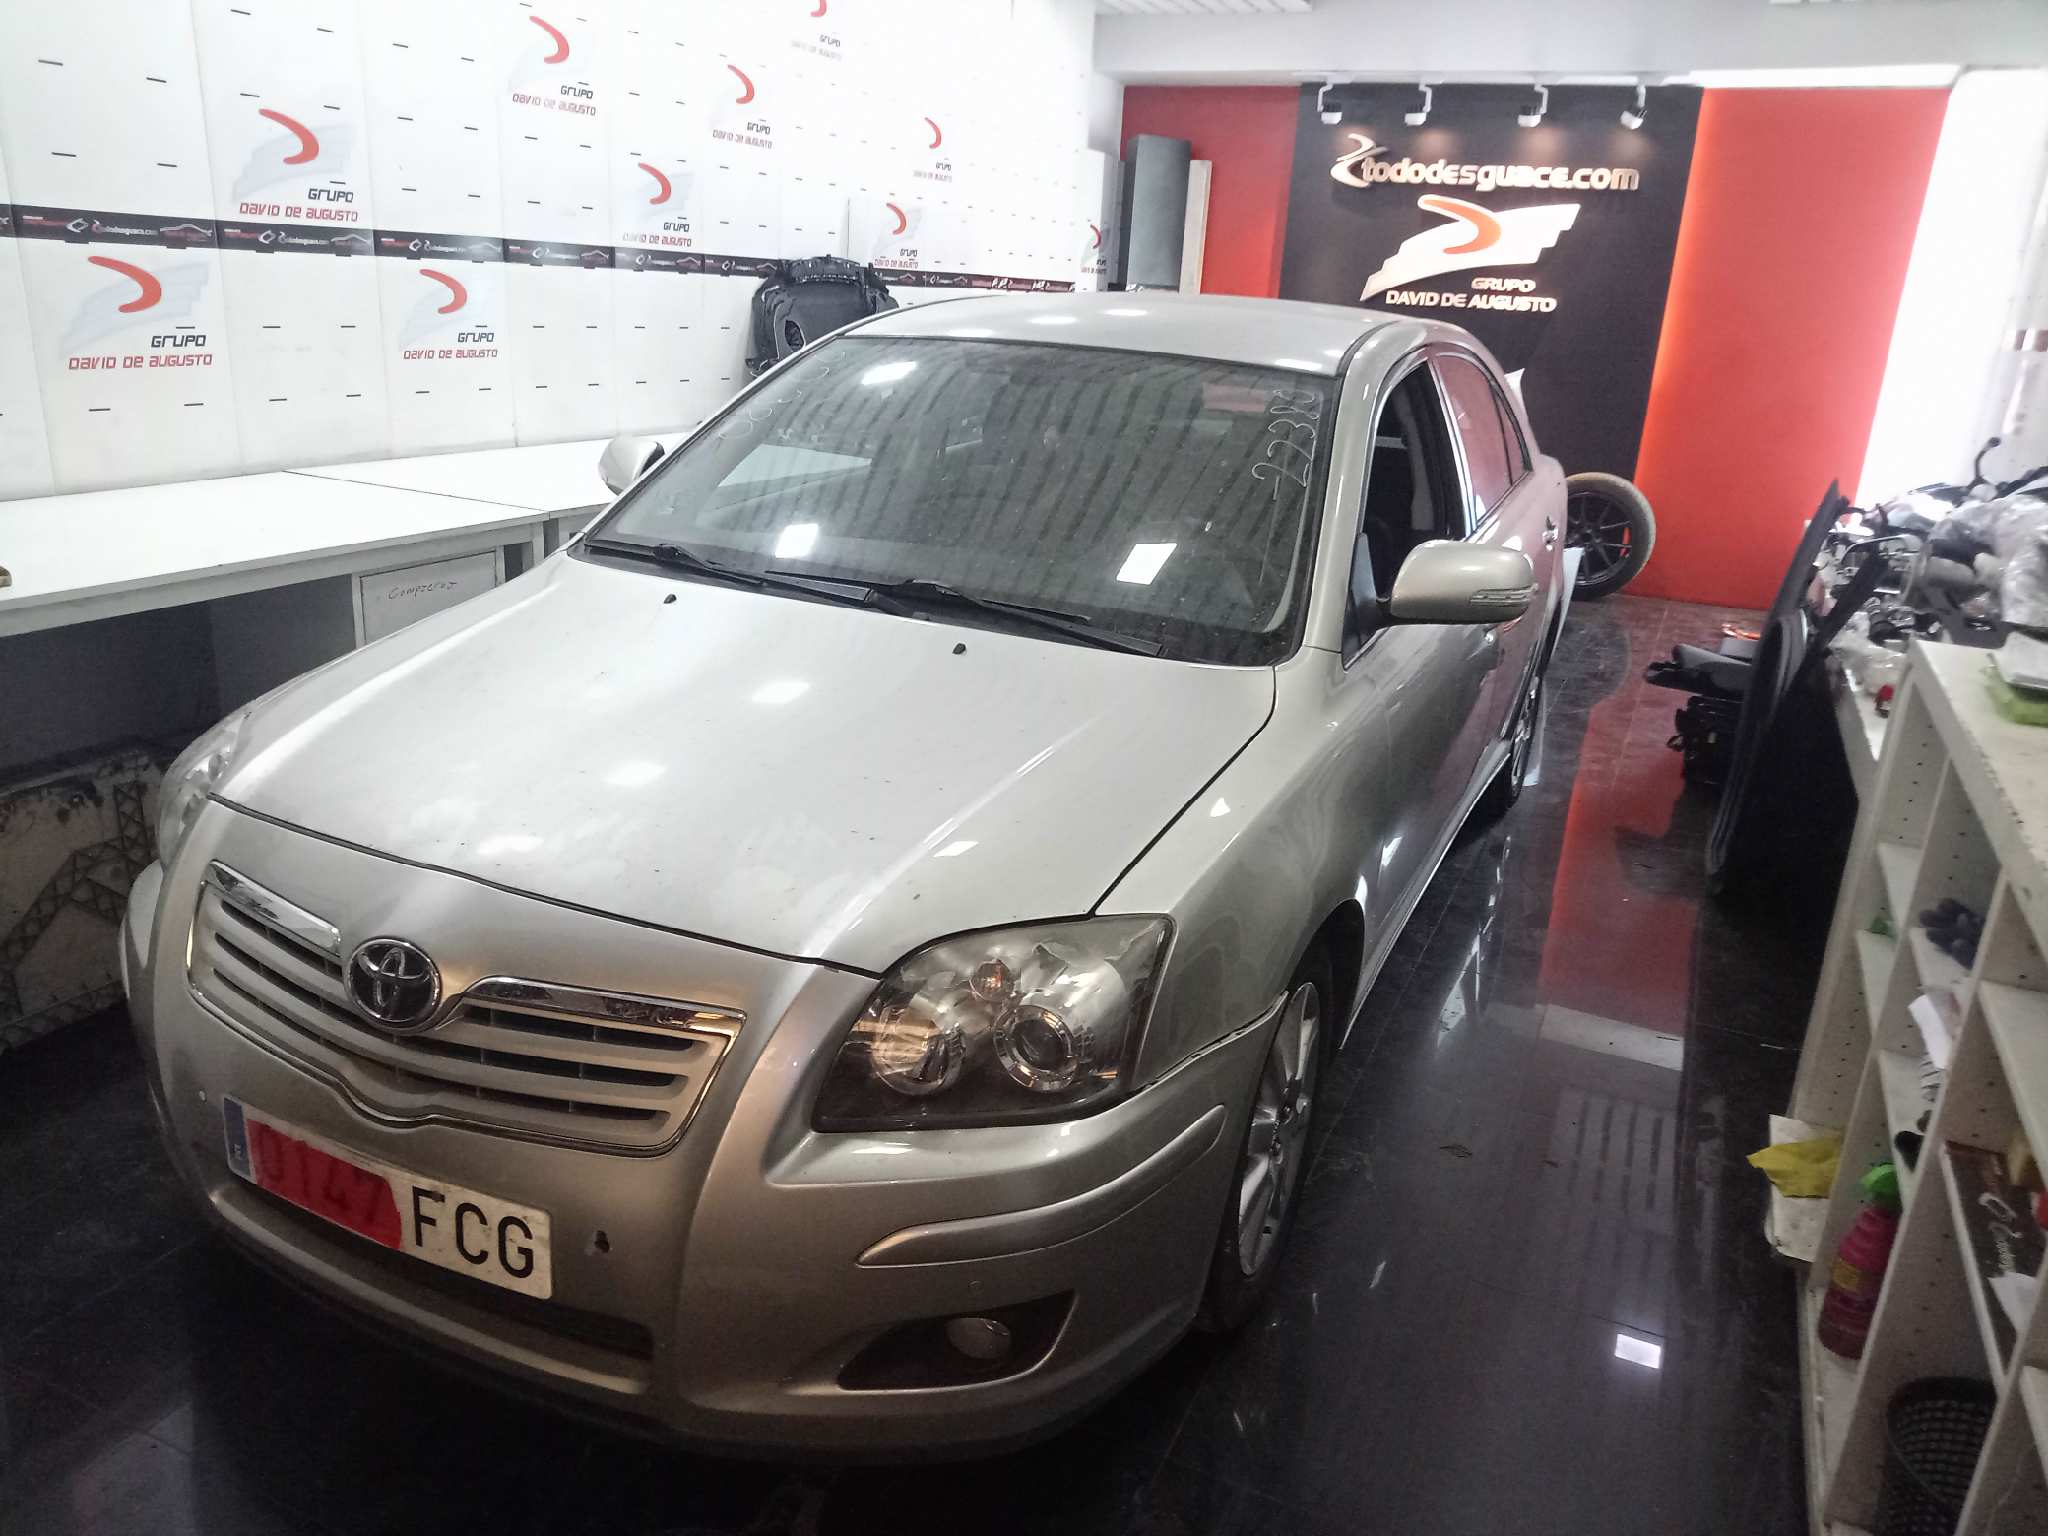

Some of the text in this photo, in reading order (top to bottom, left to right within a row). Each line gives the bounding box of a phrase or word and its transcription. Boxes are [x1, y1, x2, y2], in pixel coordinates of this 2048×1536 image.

[1361, 157, 1640, 193] tododesguace.com
[1471, 277, 1537, 292] GRUPO
[1385, 289, 1558, 312] DAVID DE AUGUSTO
[411, 1185, 535, 1280] FCG
